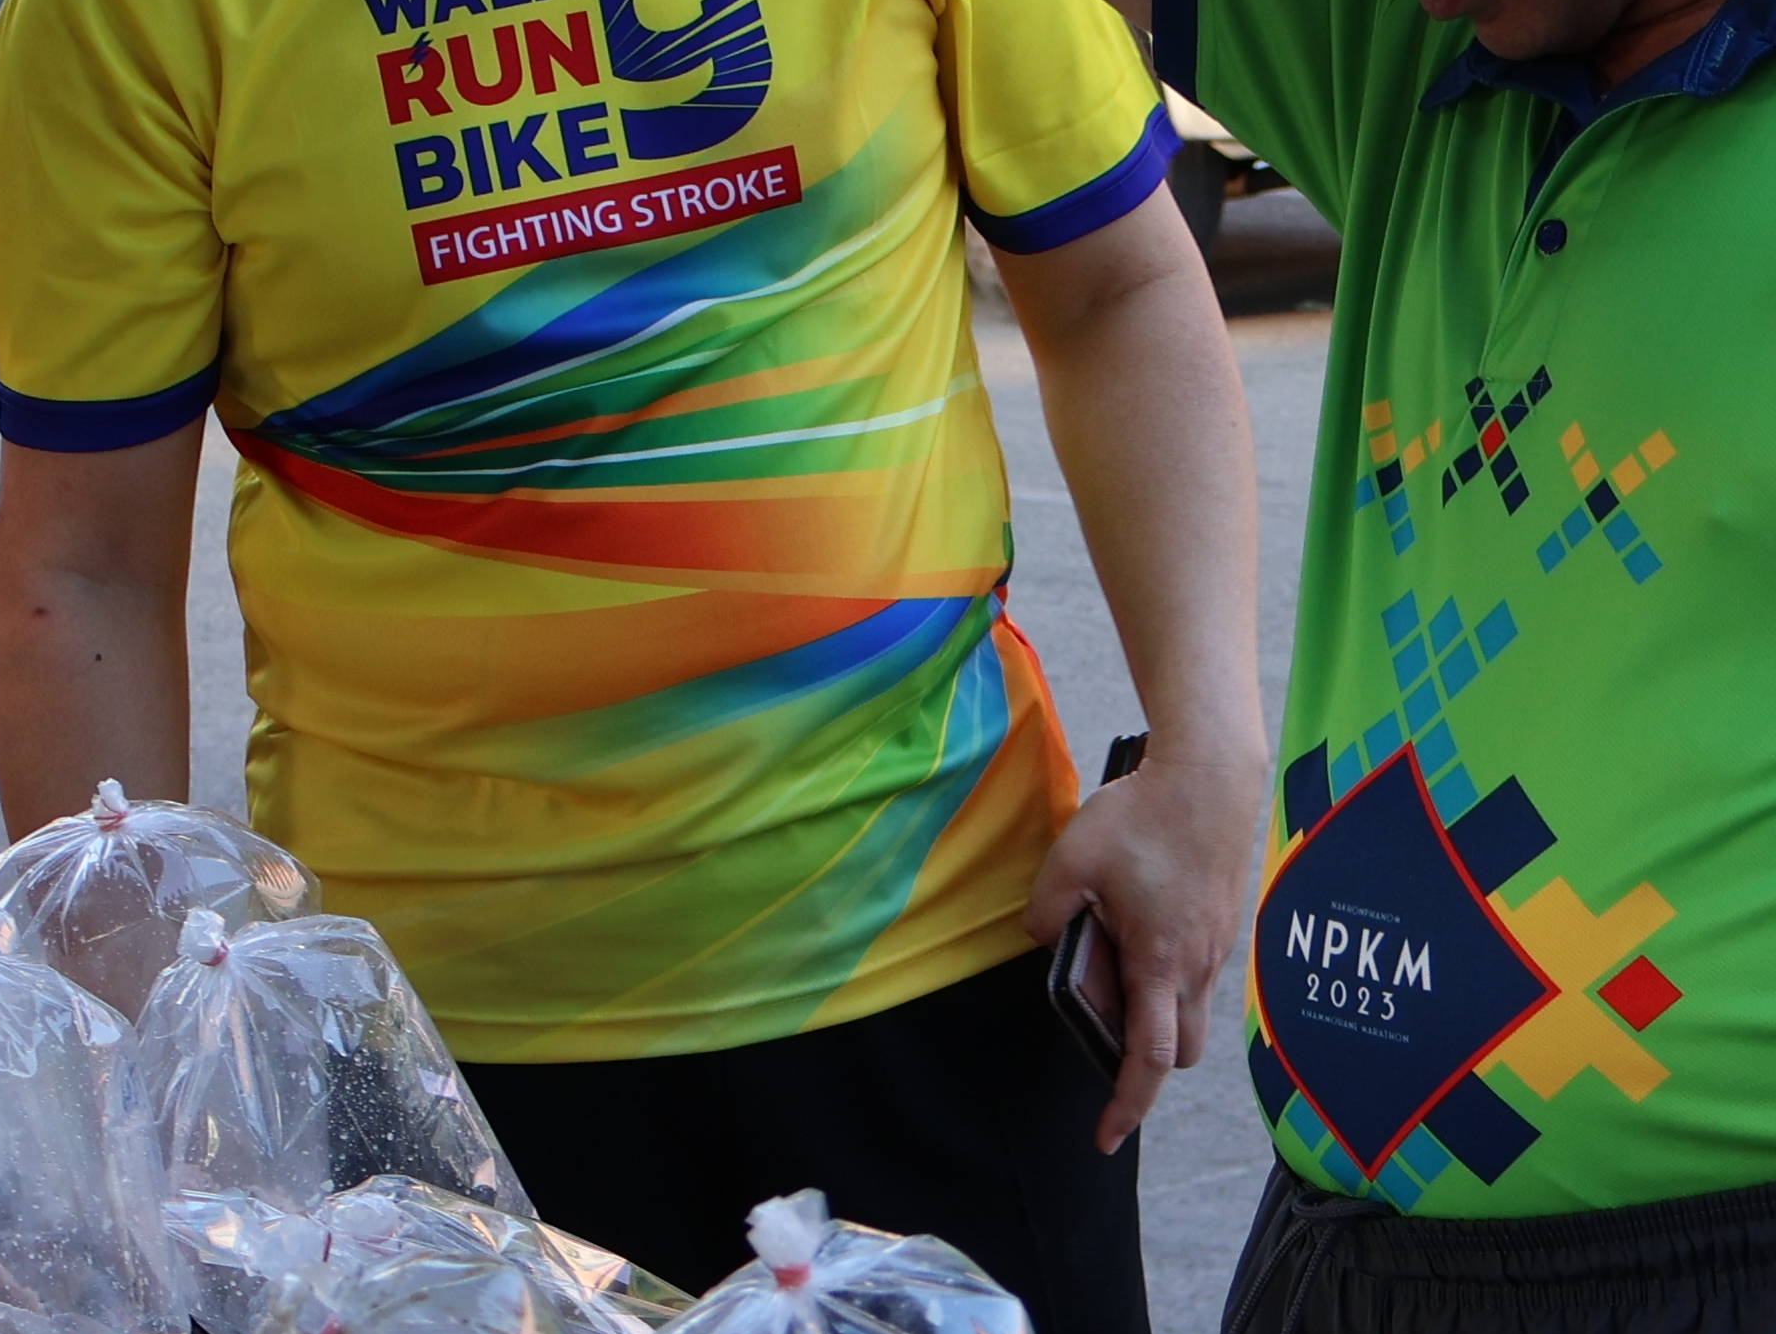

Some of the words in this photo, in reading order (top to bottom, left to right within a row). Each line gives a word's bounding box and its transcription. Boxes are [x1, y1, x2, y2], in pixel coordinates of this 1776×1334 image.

[376, 10, 601, 126] RUN
[393, 101, 620, 211] BIKE
[428, 198, 624, 270] FIGHTING
[629, 163, 788, 229] STROKE
[1286, 908, 1432, 992] NPKM
[1306, 972, 1396, 1021] 2023
